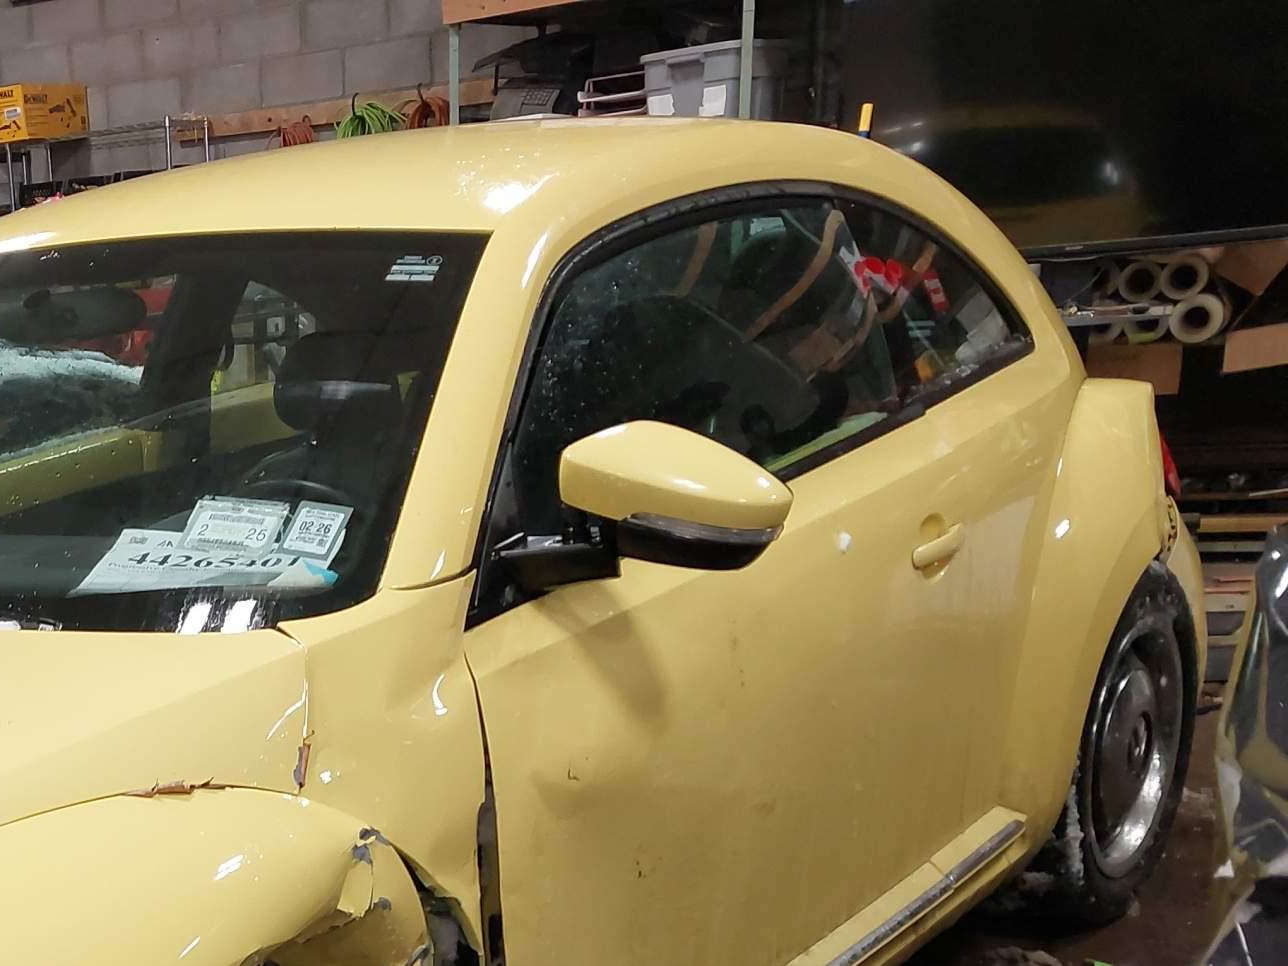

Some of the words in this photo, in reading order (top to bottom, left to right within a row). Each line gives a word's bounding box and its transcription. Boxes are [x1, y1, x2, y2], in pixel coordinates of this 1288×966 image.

[299, 521, 314, 532] 02
[316, 522, 333, 534] 26
[128, 551, 301, 569] 44265401
